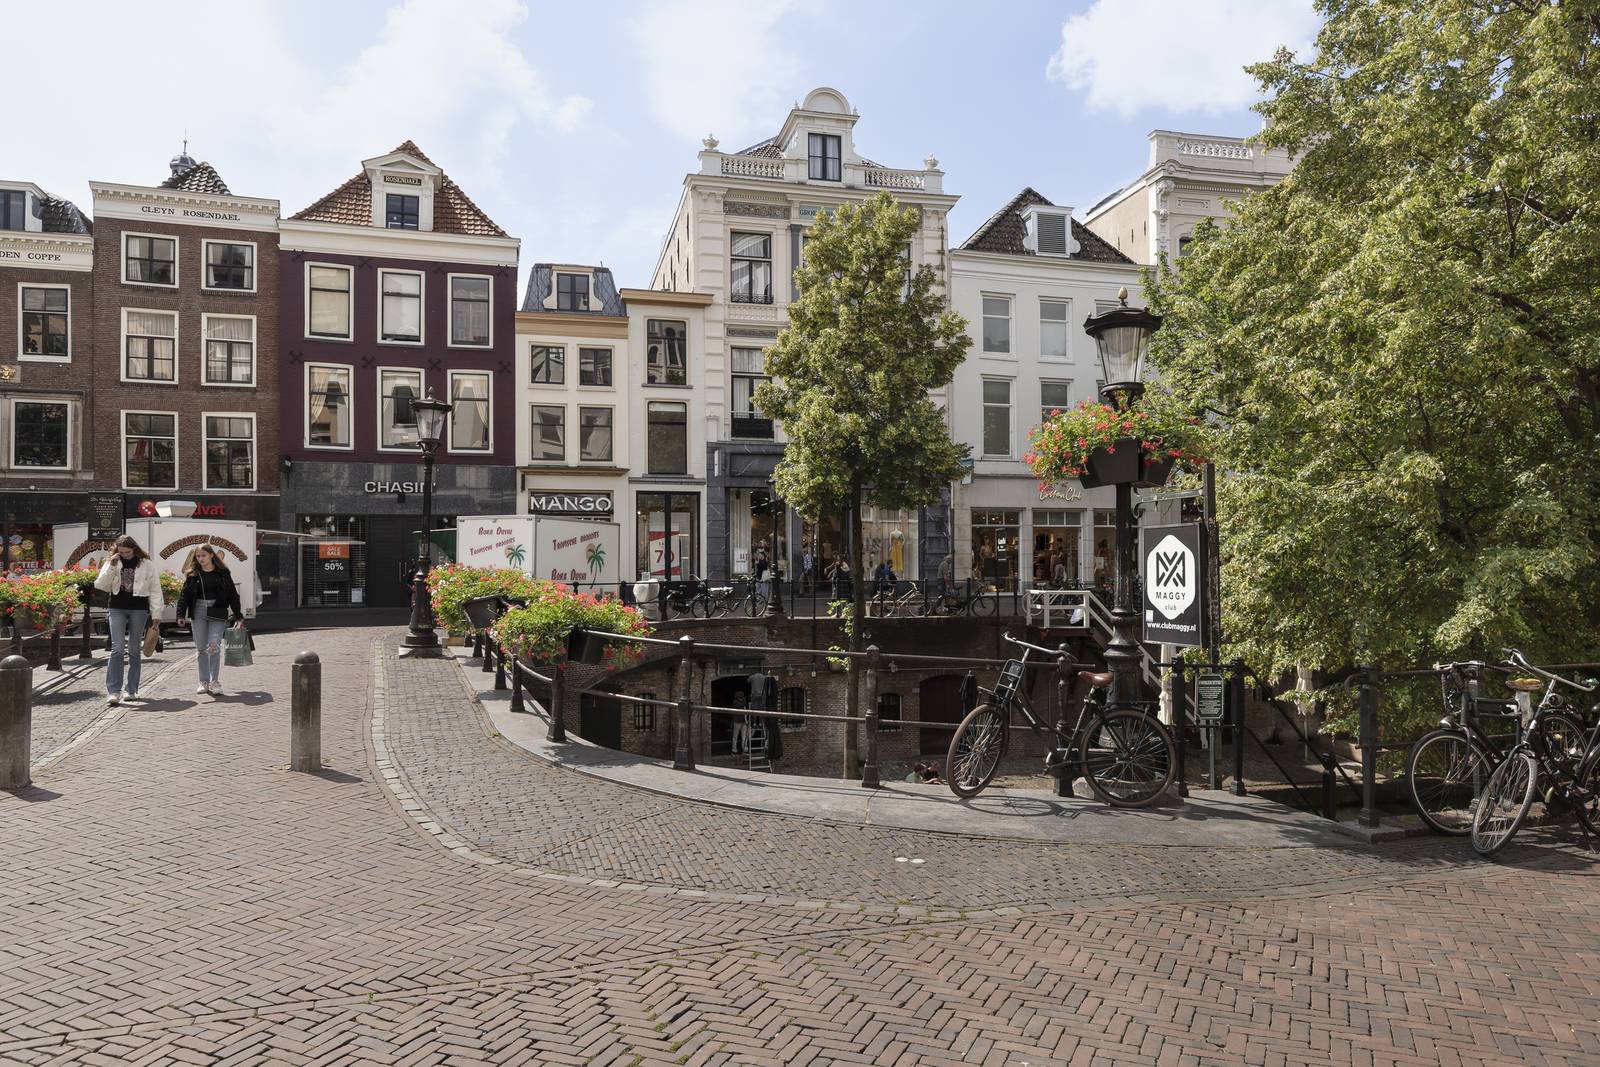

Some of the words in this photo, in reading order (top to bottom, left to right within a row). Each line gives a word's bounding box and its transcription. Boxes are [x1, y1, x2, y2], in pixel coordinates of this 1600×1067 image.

[141, 205, 175, 215] CLEYN
[183, 209, 241, 221] ROSENDAEL
[28, 252, 61, 261] COPPE
[194, 501, 225, 516] dvat
[530, 495, 612, 512] MANGO
[324, 562, 344, 571] 50%
[1155, 591, 1187, 601] MAGGY
[1164, 603, 1177, 611] club
[1146, 621, 1197, 633] www.clubmaggy.nl
